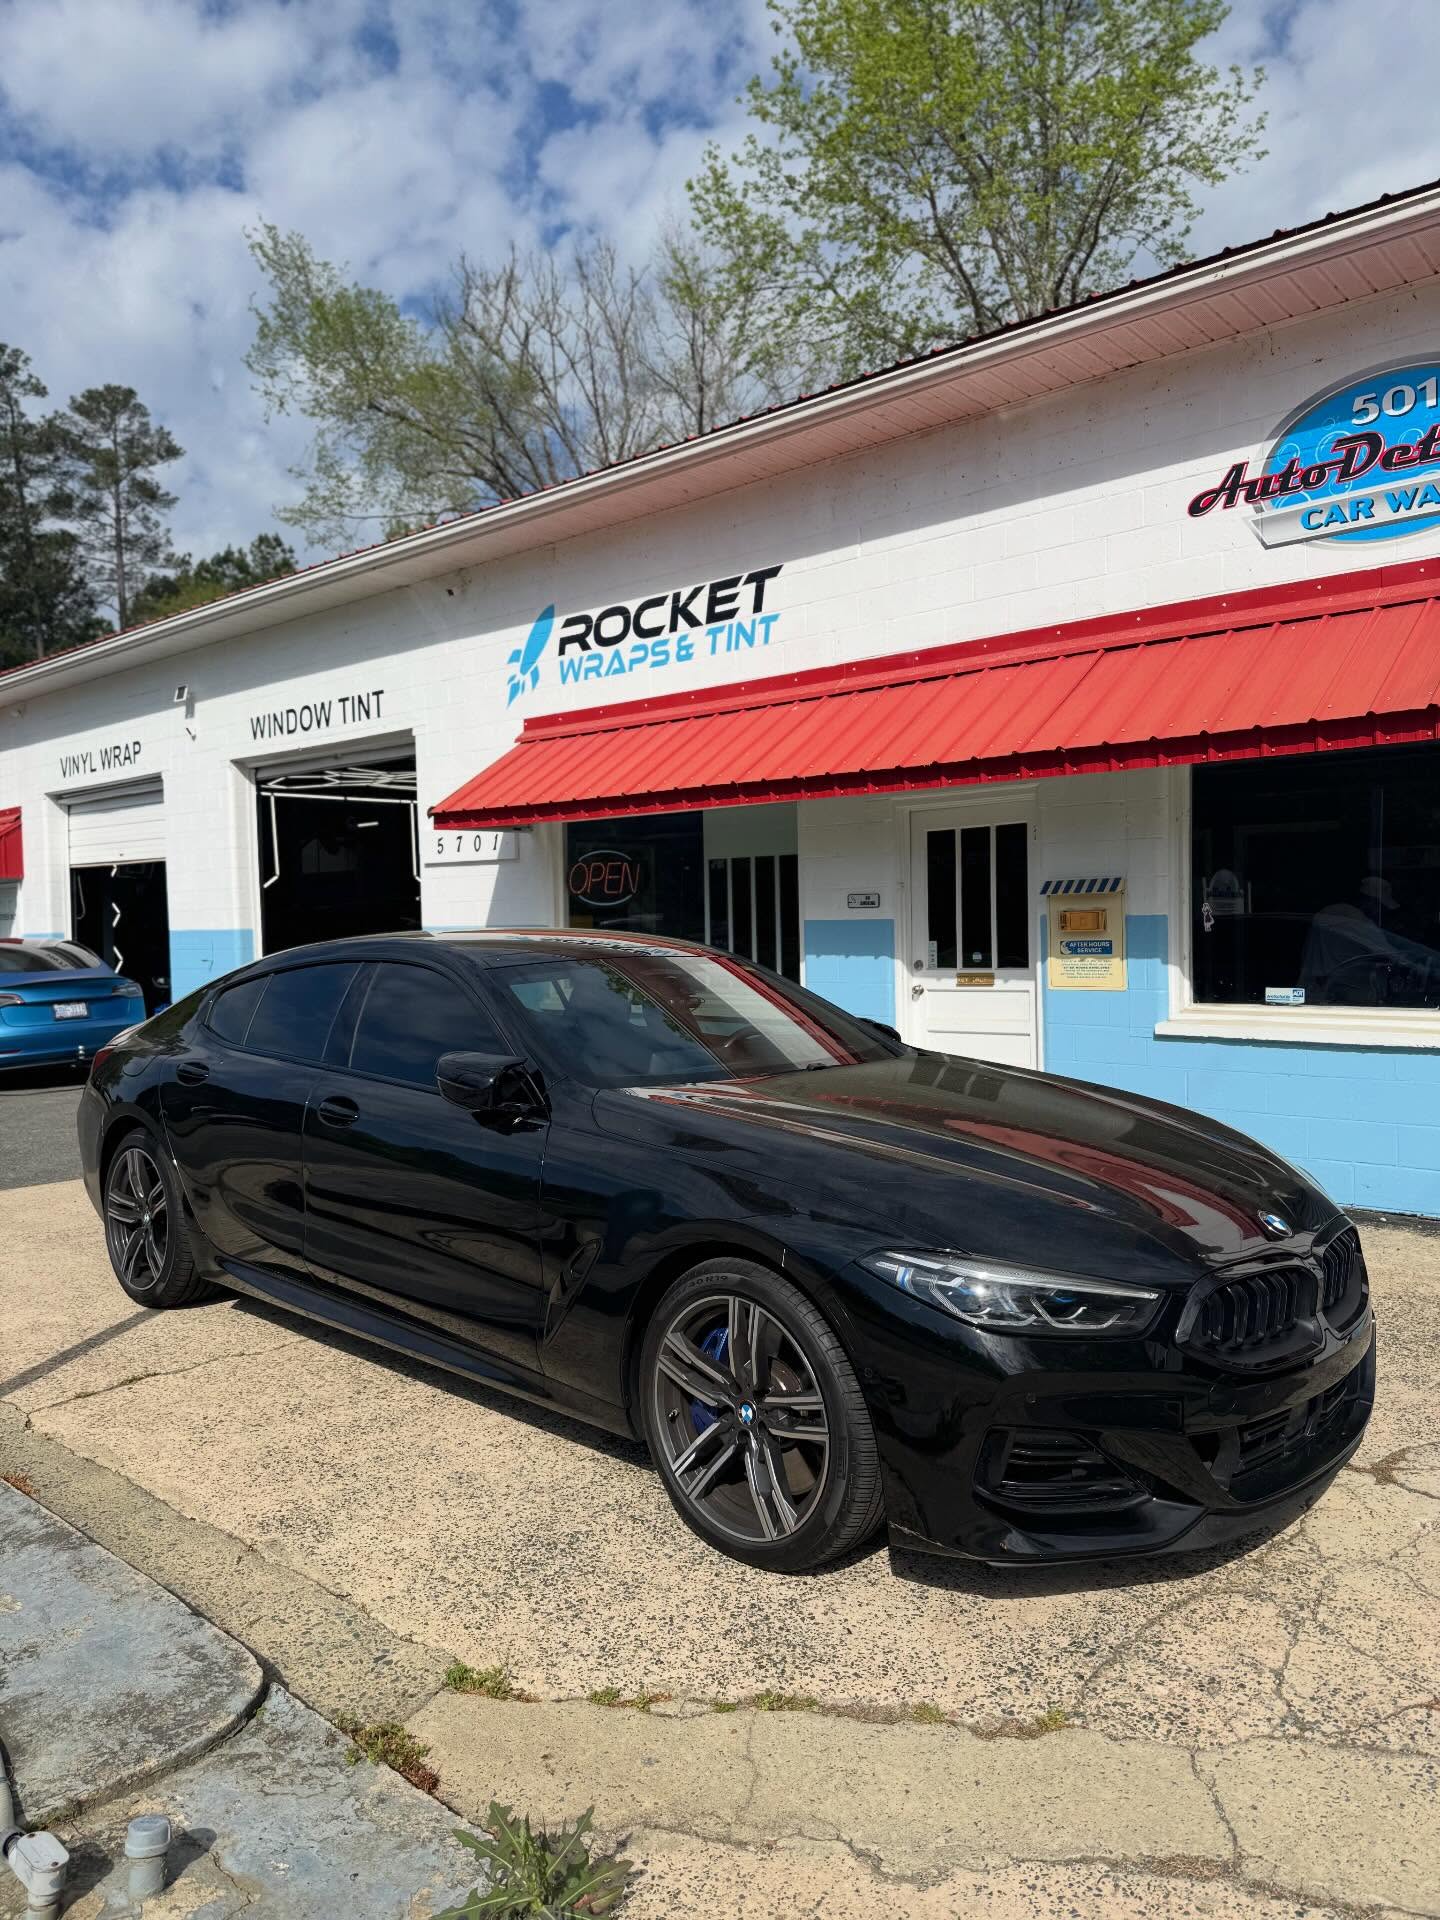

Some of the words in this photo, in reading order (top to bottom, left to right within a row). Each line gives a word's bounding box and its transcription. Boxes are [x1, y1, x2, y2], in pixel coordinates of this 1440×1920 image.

[1350, 376, 1439, 427] 501
[1299, 497, 1375, 531] CAR
[1383, 482, 1440, 514] WA
[558, 564, 784, 657] ROCKET
[559, 636, 670, 686] WRAPS
[676, 633, 695, 662] &
[705, 613, 781, 656] TINT
[250, 700, 332, 741] WINDOW
[338, 690, 385, 725] TINT
[60, 751, 97, 779] VINYL
[100, 740, 142, 770] WRAP
[437, 834, 499, 855] 5701
[568, 861, 640, 895] OPEN
